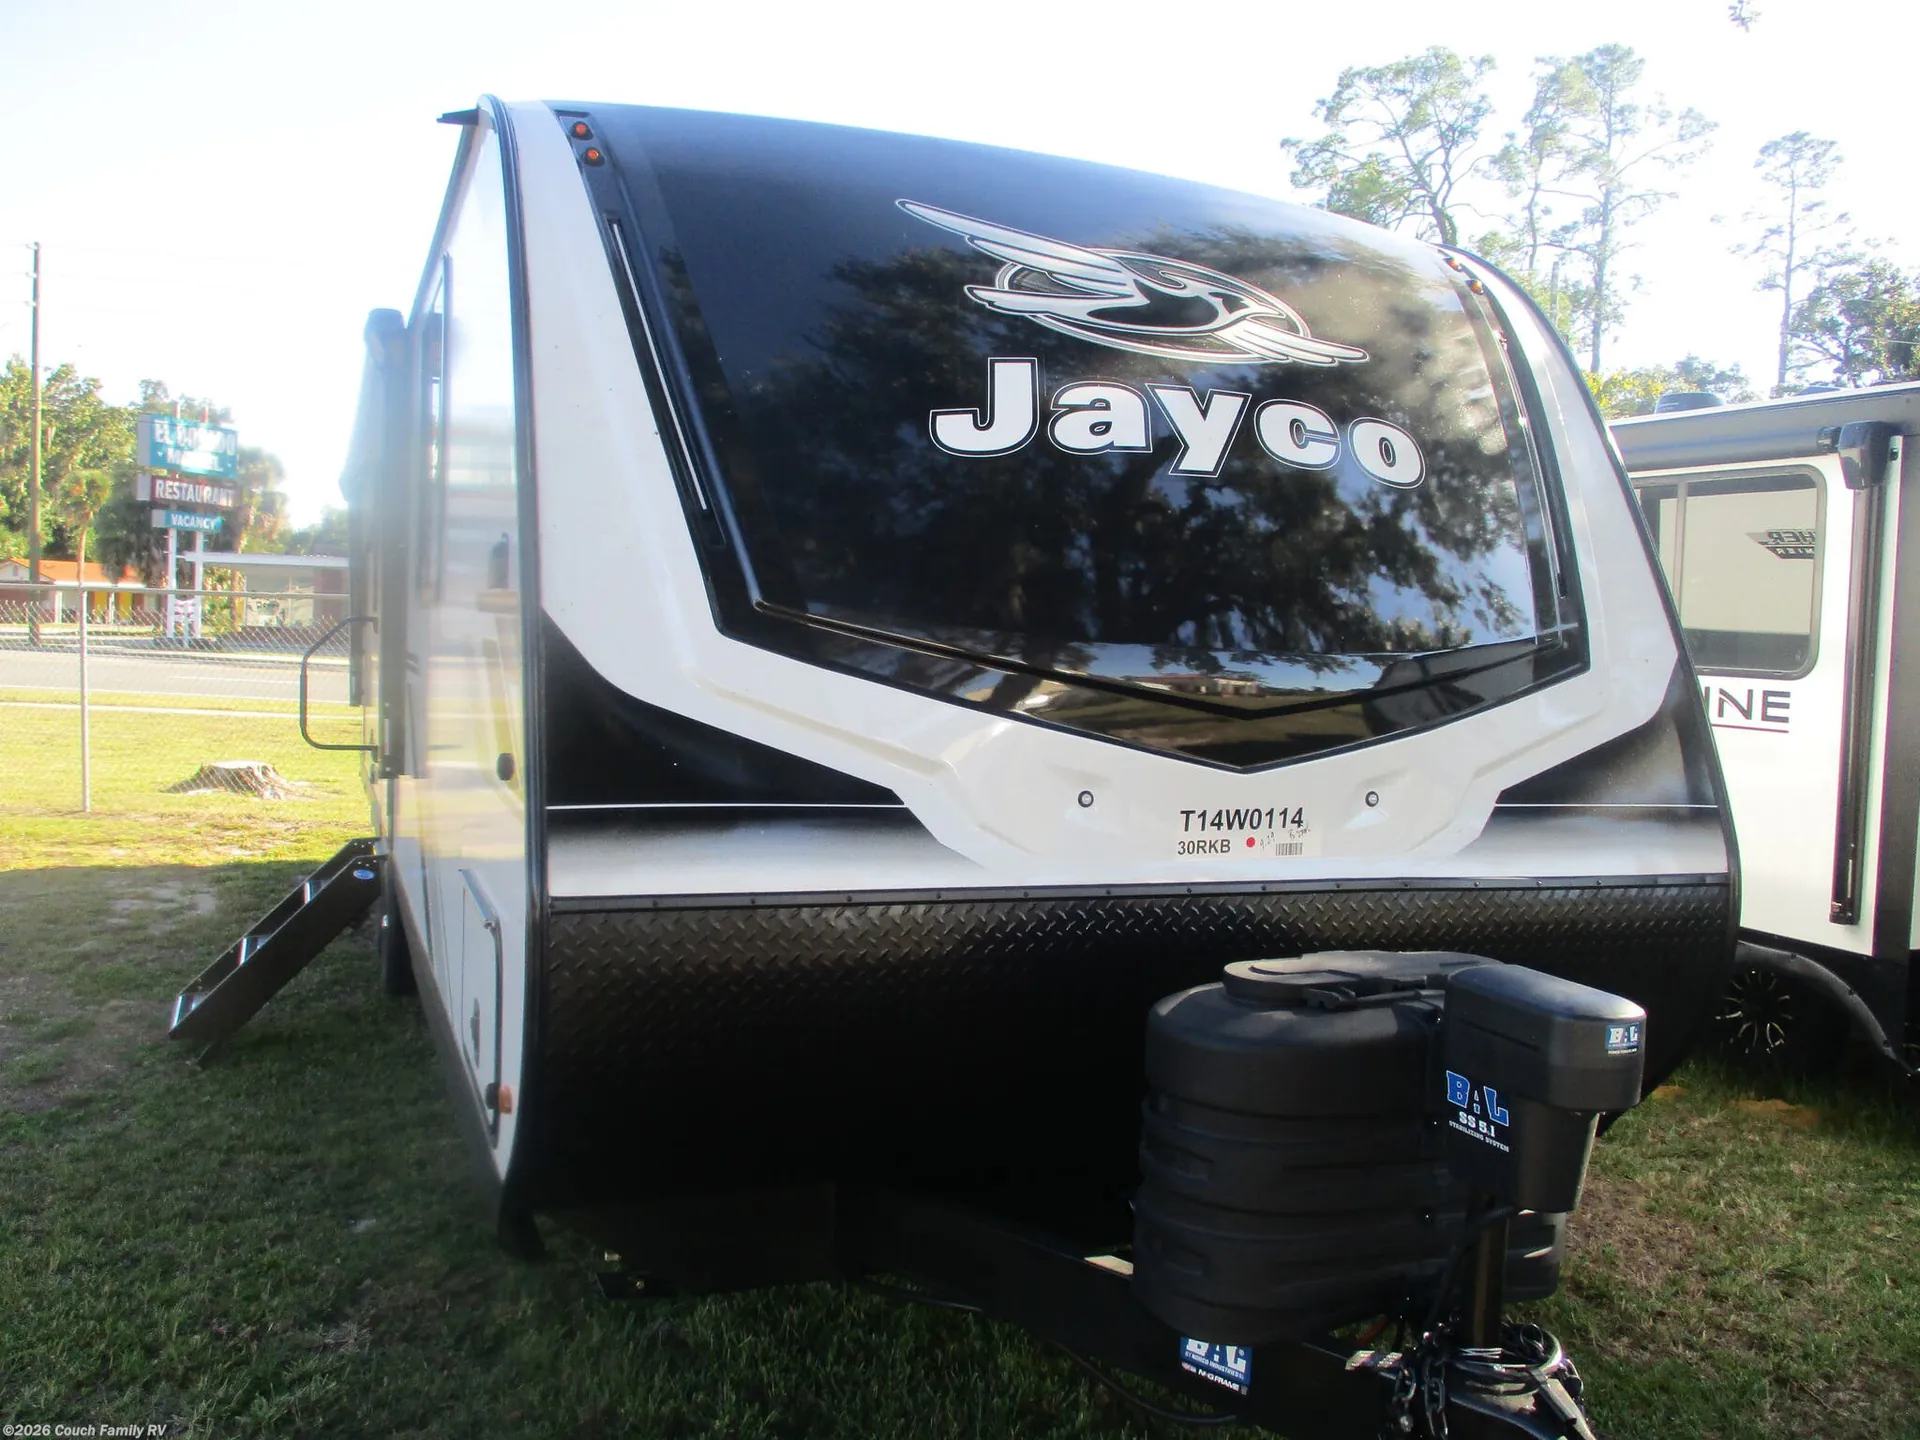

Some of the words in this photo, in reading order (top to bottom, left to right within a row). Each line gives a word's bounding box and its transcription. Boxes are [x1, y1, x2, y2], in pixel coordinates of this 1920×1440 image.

[929, 357, 1426, 489] Jayco
[155, 479, 233, 507] RESTAURANT
[171, 513, 217, 529] VACANCY
[1180, 807, 1304, 832] T14W0114
[1177, 839, 1231, 855] 30RKB
[1446, 1070, 1509, 1127] BAL
[1459, 1111, 1476, 1128] SS
[1479, 1120, 1495, 1137] 5.1
